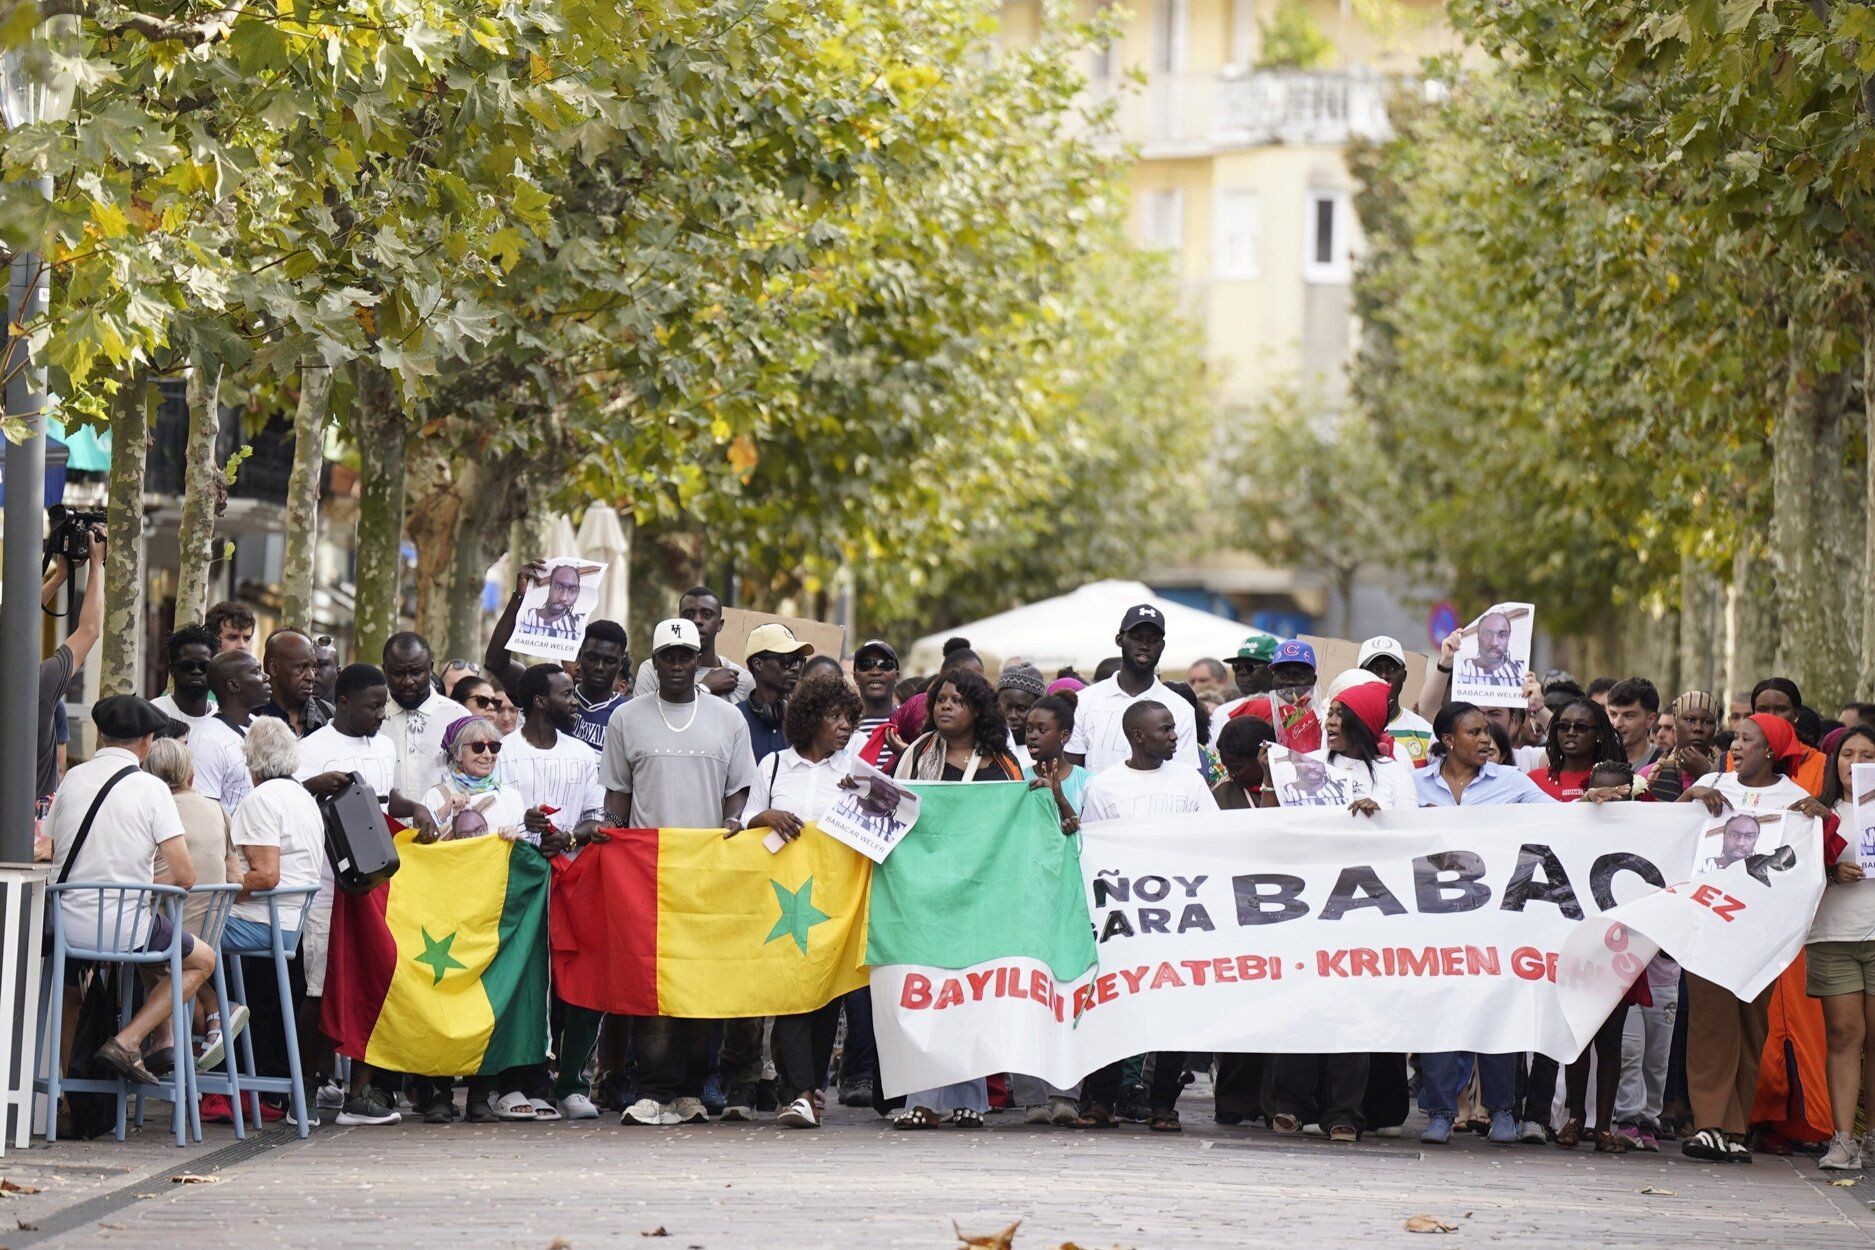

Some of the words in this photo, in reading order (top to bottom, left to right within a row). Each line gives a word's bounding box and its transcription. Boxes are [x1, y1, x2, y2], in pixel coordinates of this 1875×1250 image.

[514, 637, 549, 649] BABACAR
[549, 642, 575, 652] WELER
[1456, 689, 1495, 698] BABACAR
[825, 815, 860, 839] BABACAR
[859, 834, 886, 853] WELER
[1092, 869, 1209, 909] ÑOY
[1091, 903, 1216, 944] ARA
[899, 966, 1065, 1023] BAYILEN
[1072, 954, 1282, 1019] REYATEBI
[1315, 944, 1502, 978] KRIMEN
